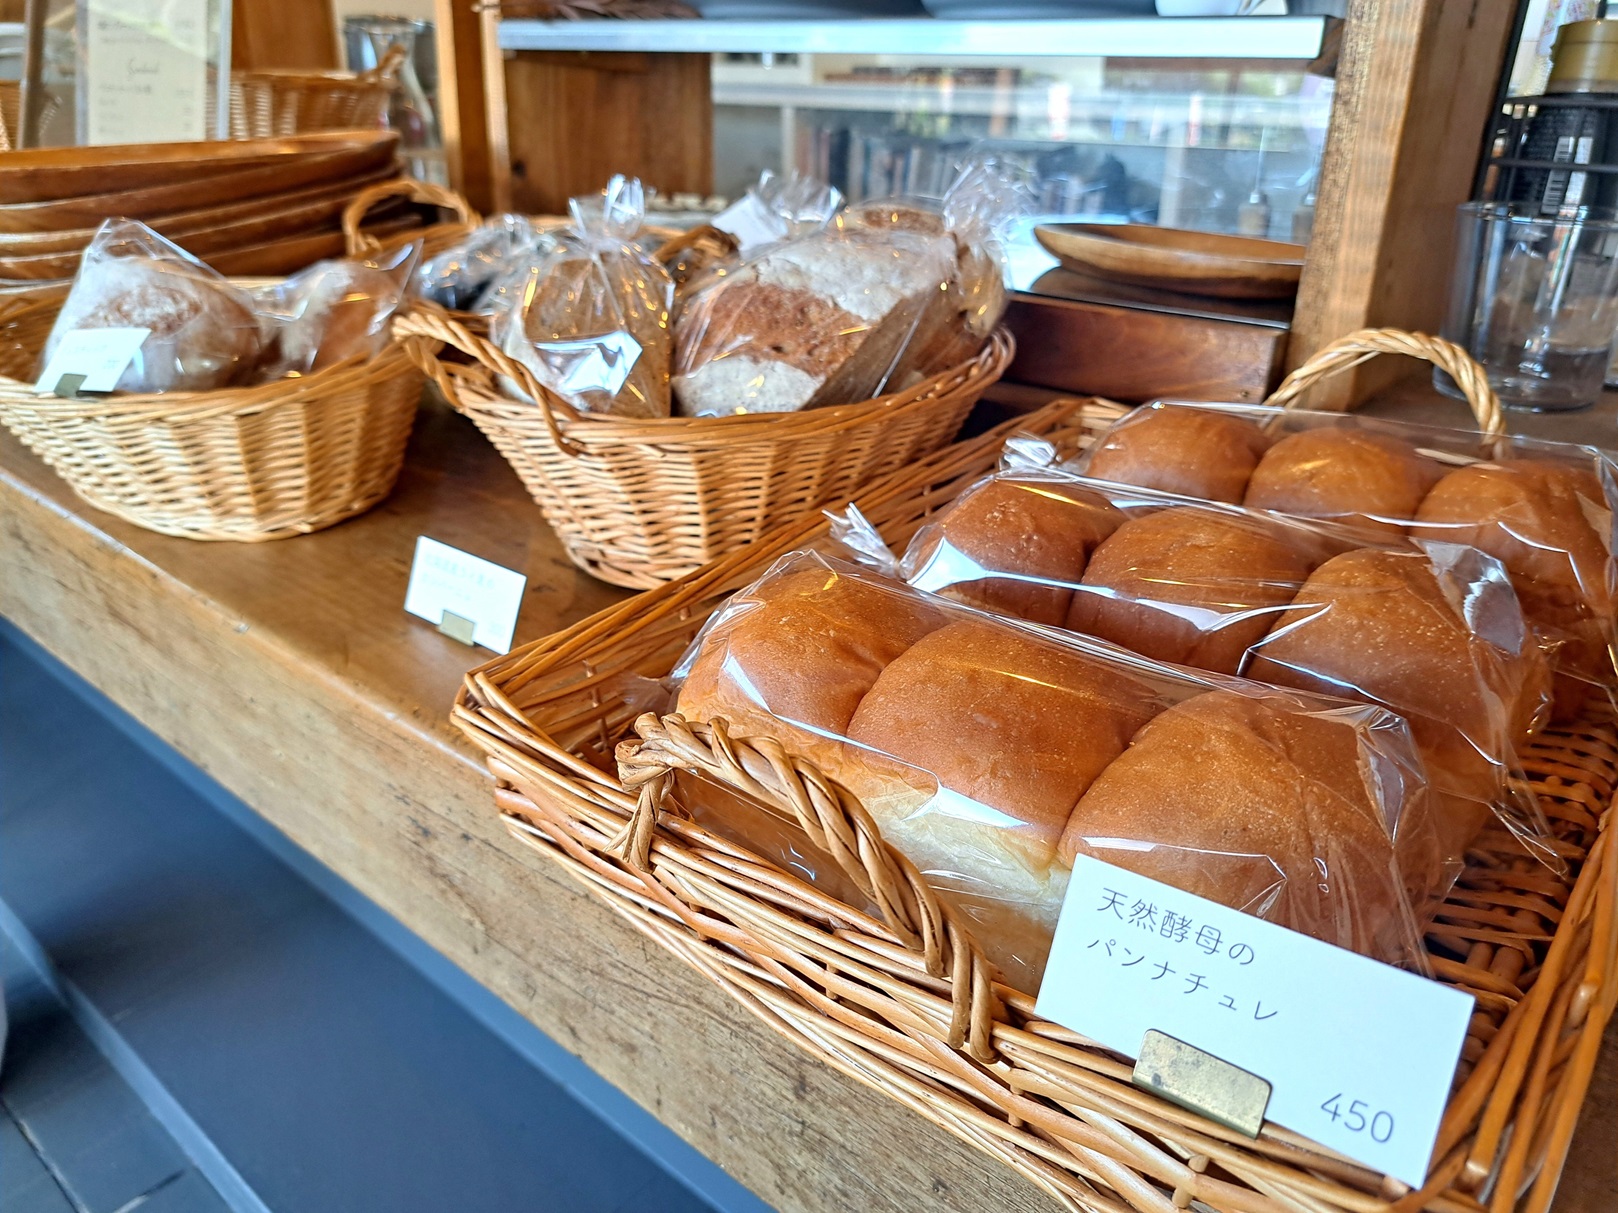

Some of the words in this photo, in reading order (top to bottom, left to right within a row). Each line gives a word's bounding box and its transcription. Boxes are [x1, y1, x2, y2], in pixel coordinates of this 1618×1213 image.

[1096, 887, 1255, 966] 天然酵母の
[1086, 938, 1279, 1021] パンナチュレ
[1320, 1092, 1394, 1143] 450
